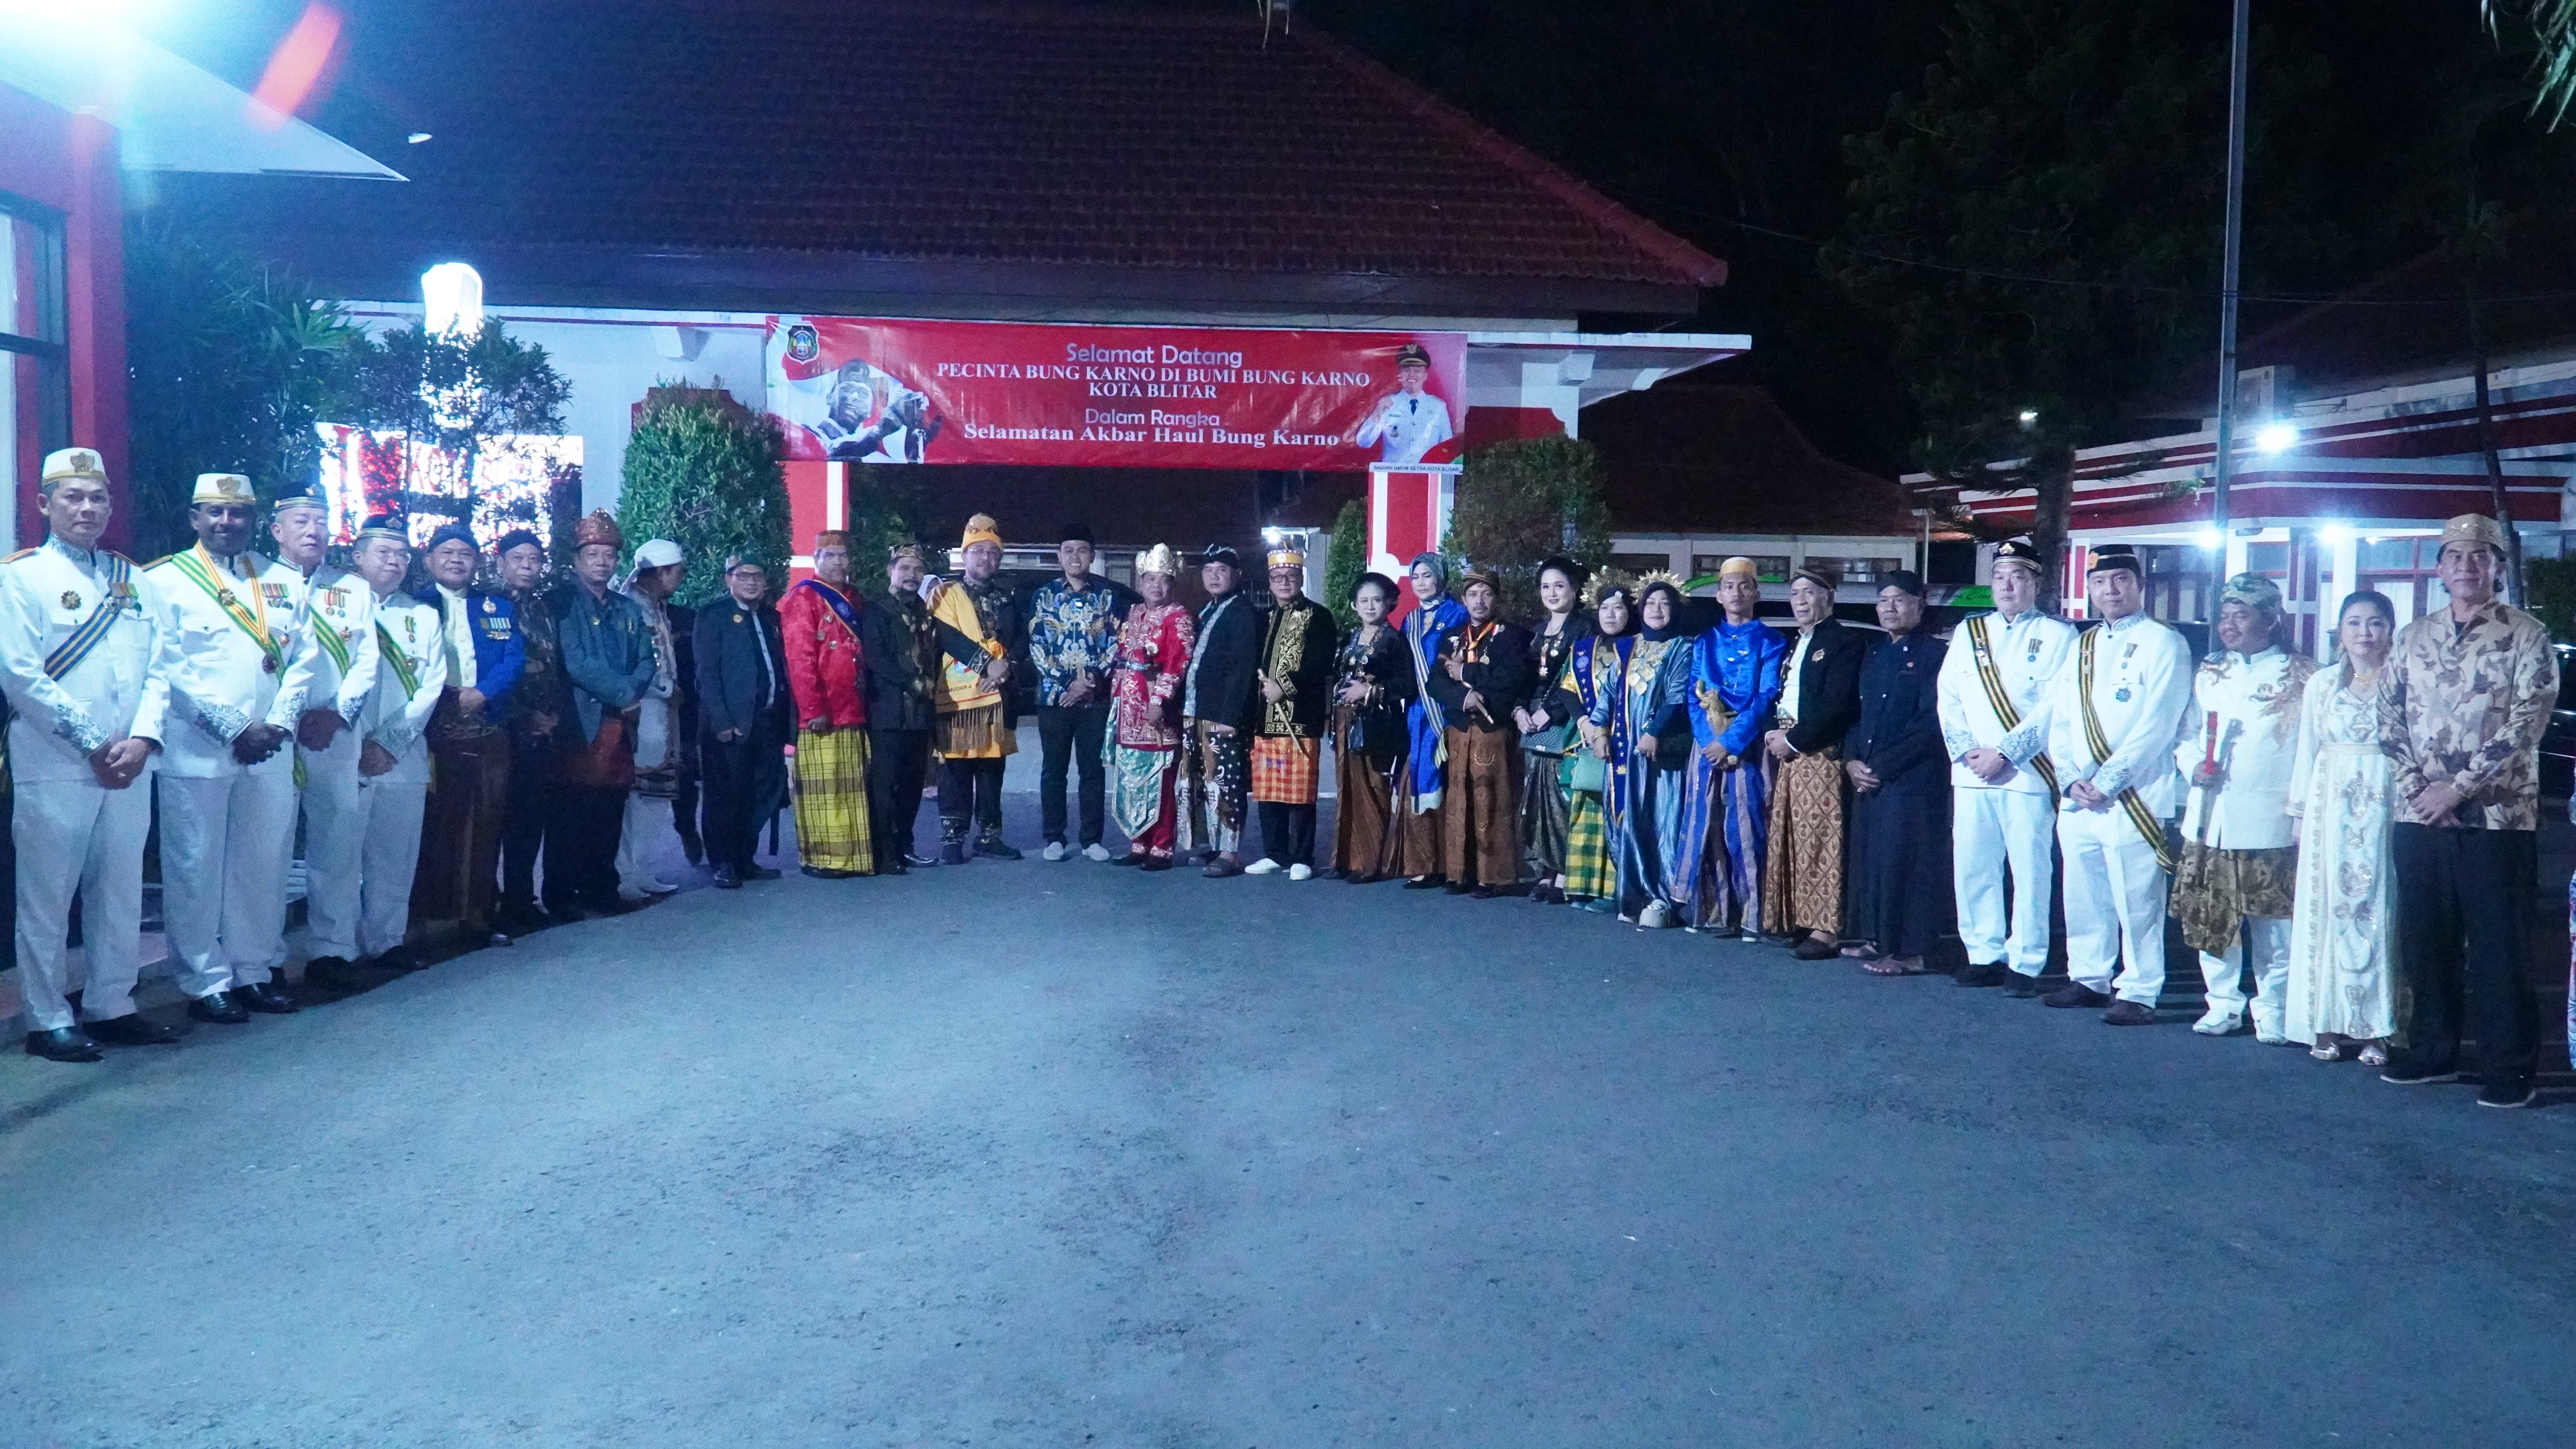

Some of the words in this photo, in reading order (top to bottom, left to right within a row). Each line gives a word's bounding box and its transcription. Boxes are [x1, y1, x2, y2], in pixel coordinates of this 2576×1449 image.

[1067, 343, 1154, 363] Selamat
[1162, 345, 1242, 368] Datang
[938, 363, 1021, 378] PECINTA
[1026, 365, 1080, 379] BUNG
[1086, 366, 1155, 381] KARNO
[1161, 368, 1180, 382] DI
[1187, 368, 1237, 383] BUMI
[1243, 370, 1295, 384] BUNG
[1301, 371, 1370, 386] KARNO
[1090, 382, 1142, 397] KOTA
[1148, 384, 1217, 398] BLITAR
[1086, 408, 1145, 424] Dalam
[1151, 409, 1220, 428] Rangka
[964, 424, 1074, 440] Selamatan
[1080, 426, 1147, 442] Akbar
[1155, 428, 1204, 443] Haul
[1212, 429, 1266, 448] Bung
[1273, 429, 1339, 446] Karno
